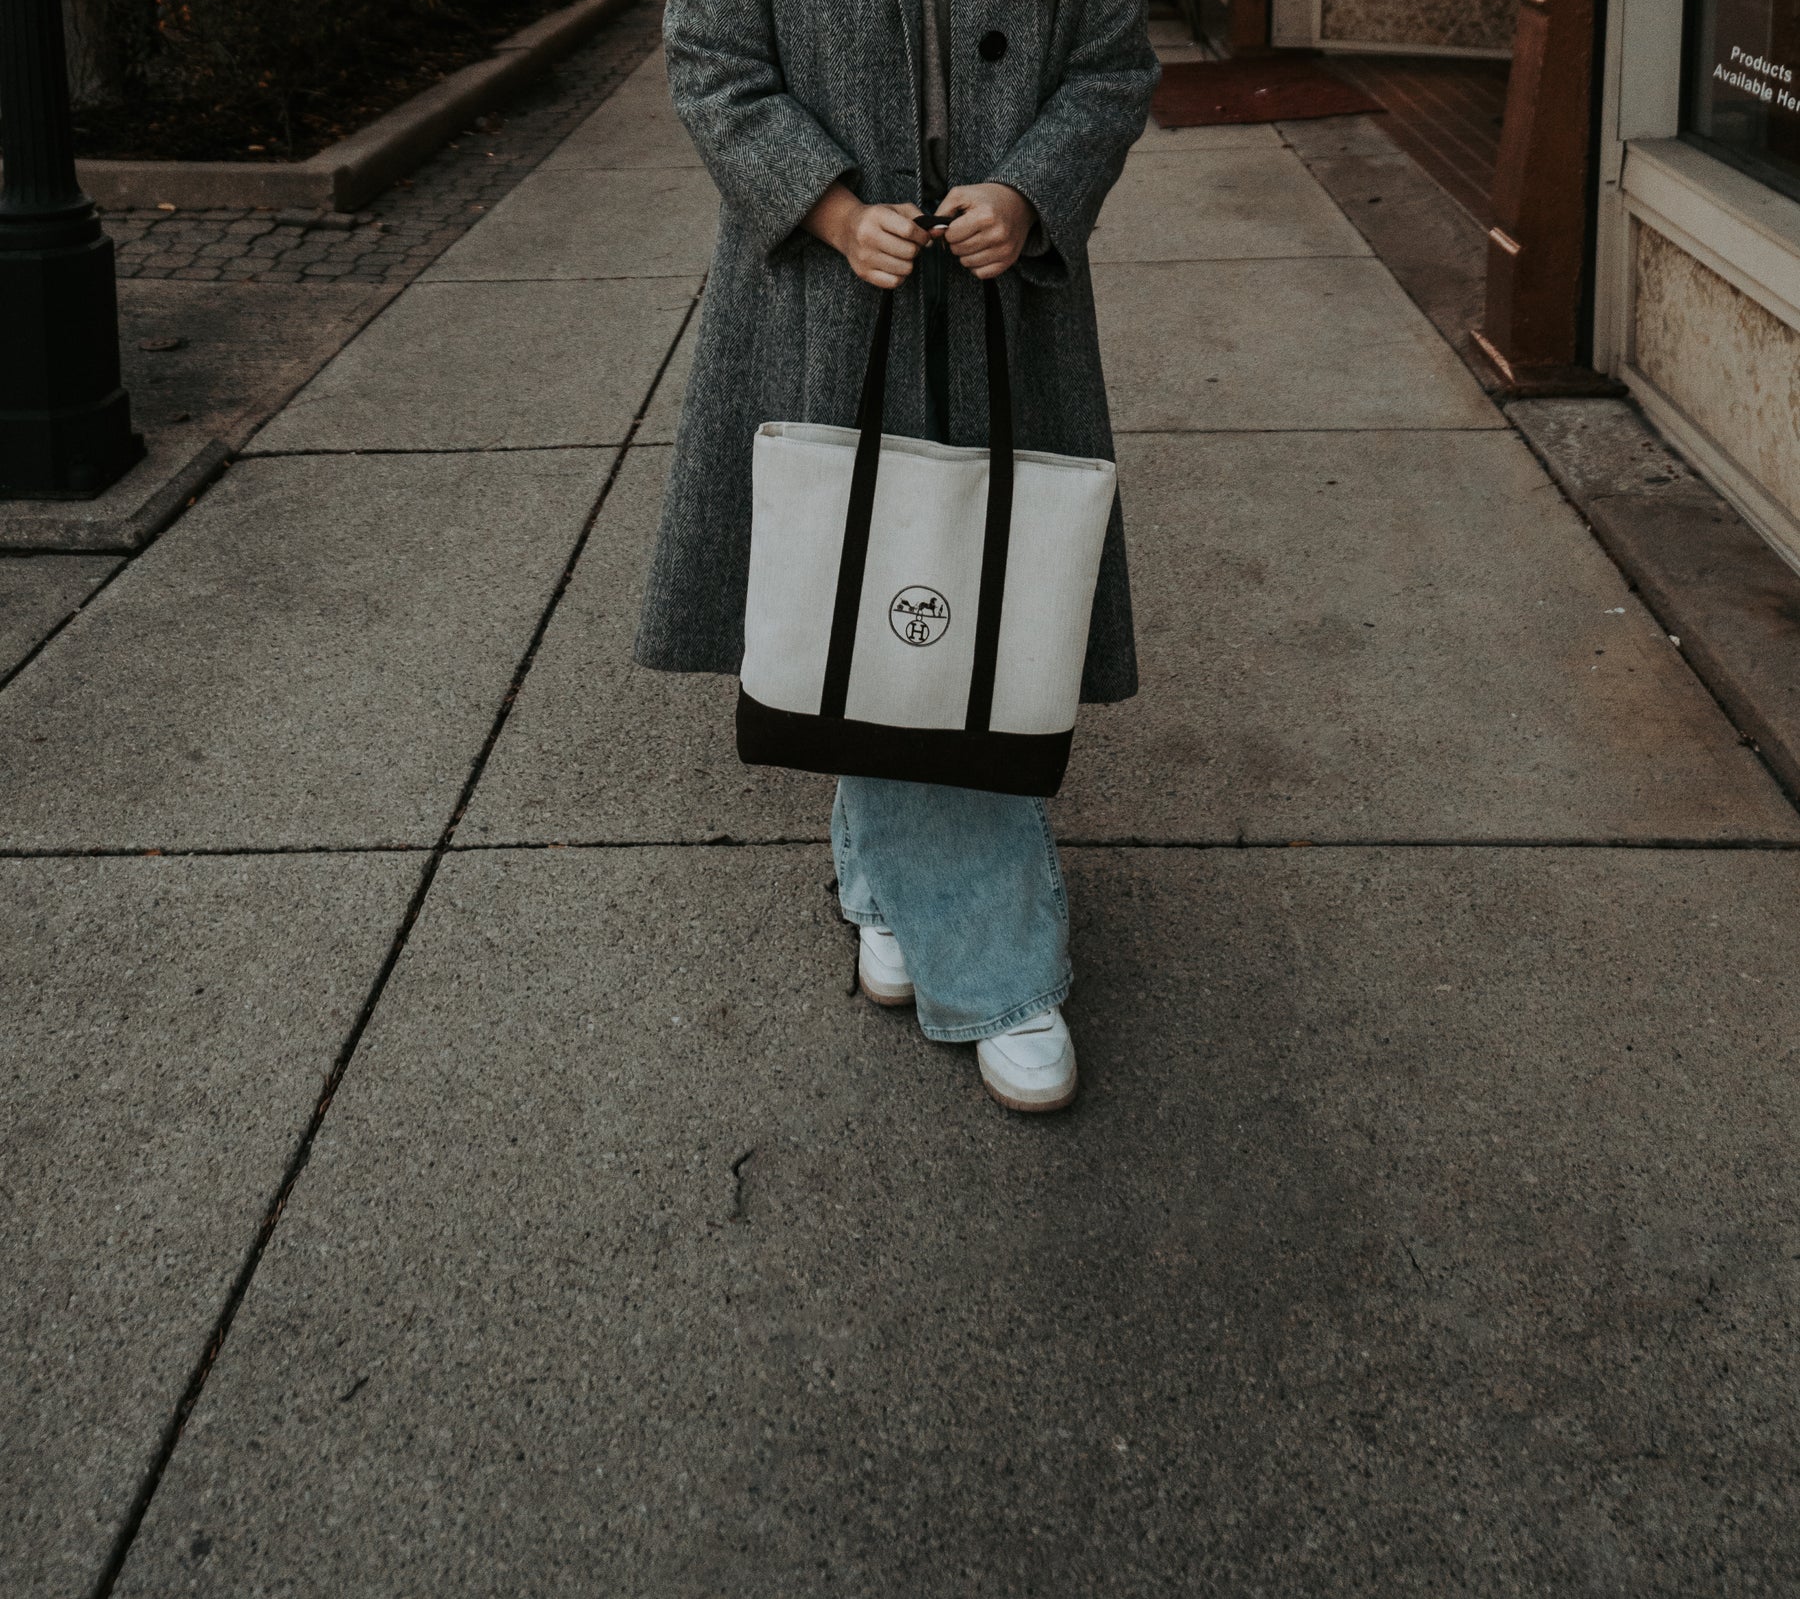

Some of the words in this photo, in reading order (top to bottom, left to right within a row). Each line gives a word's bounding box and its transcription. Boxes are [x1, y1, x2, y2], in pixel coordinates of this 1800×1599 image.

[1713, 63, 1774, 101] Available
[1730, 45, 1793, 82] Products
[908, 622, 927, 641] H
